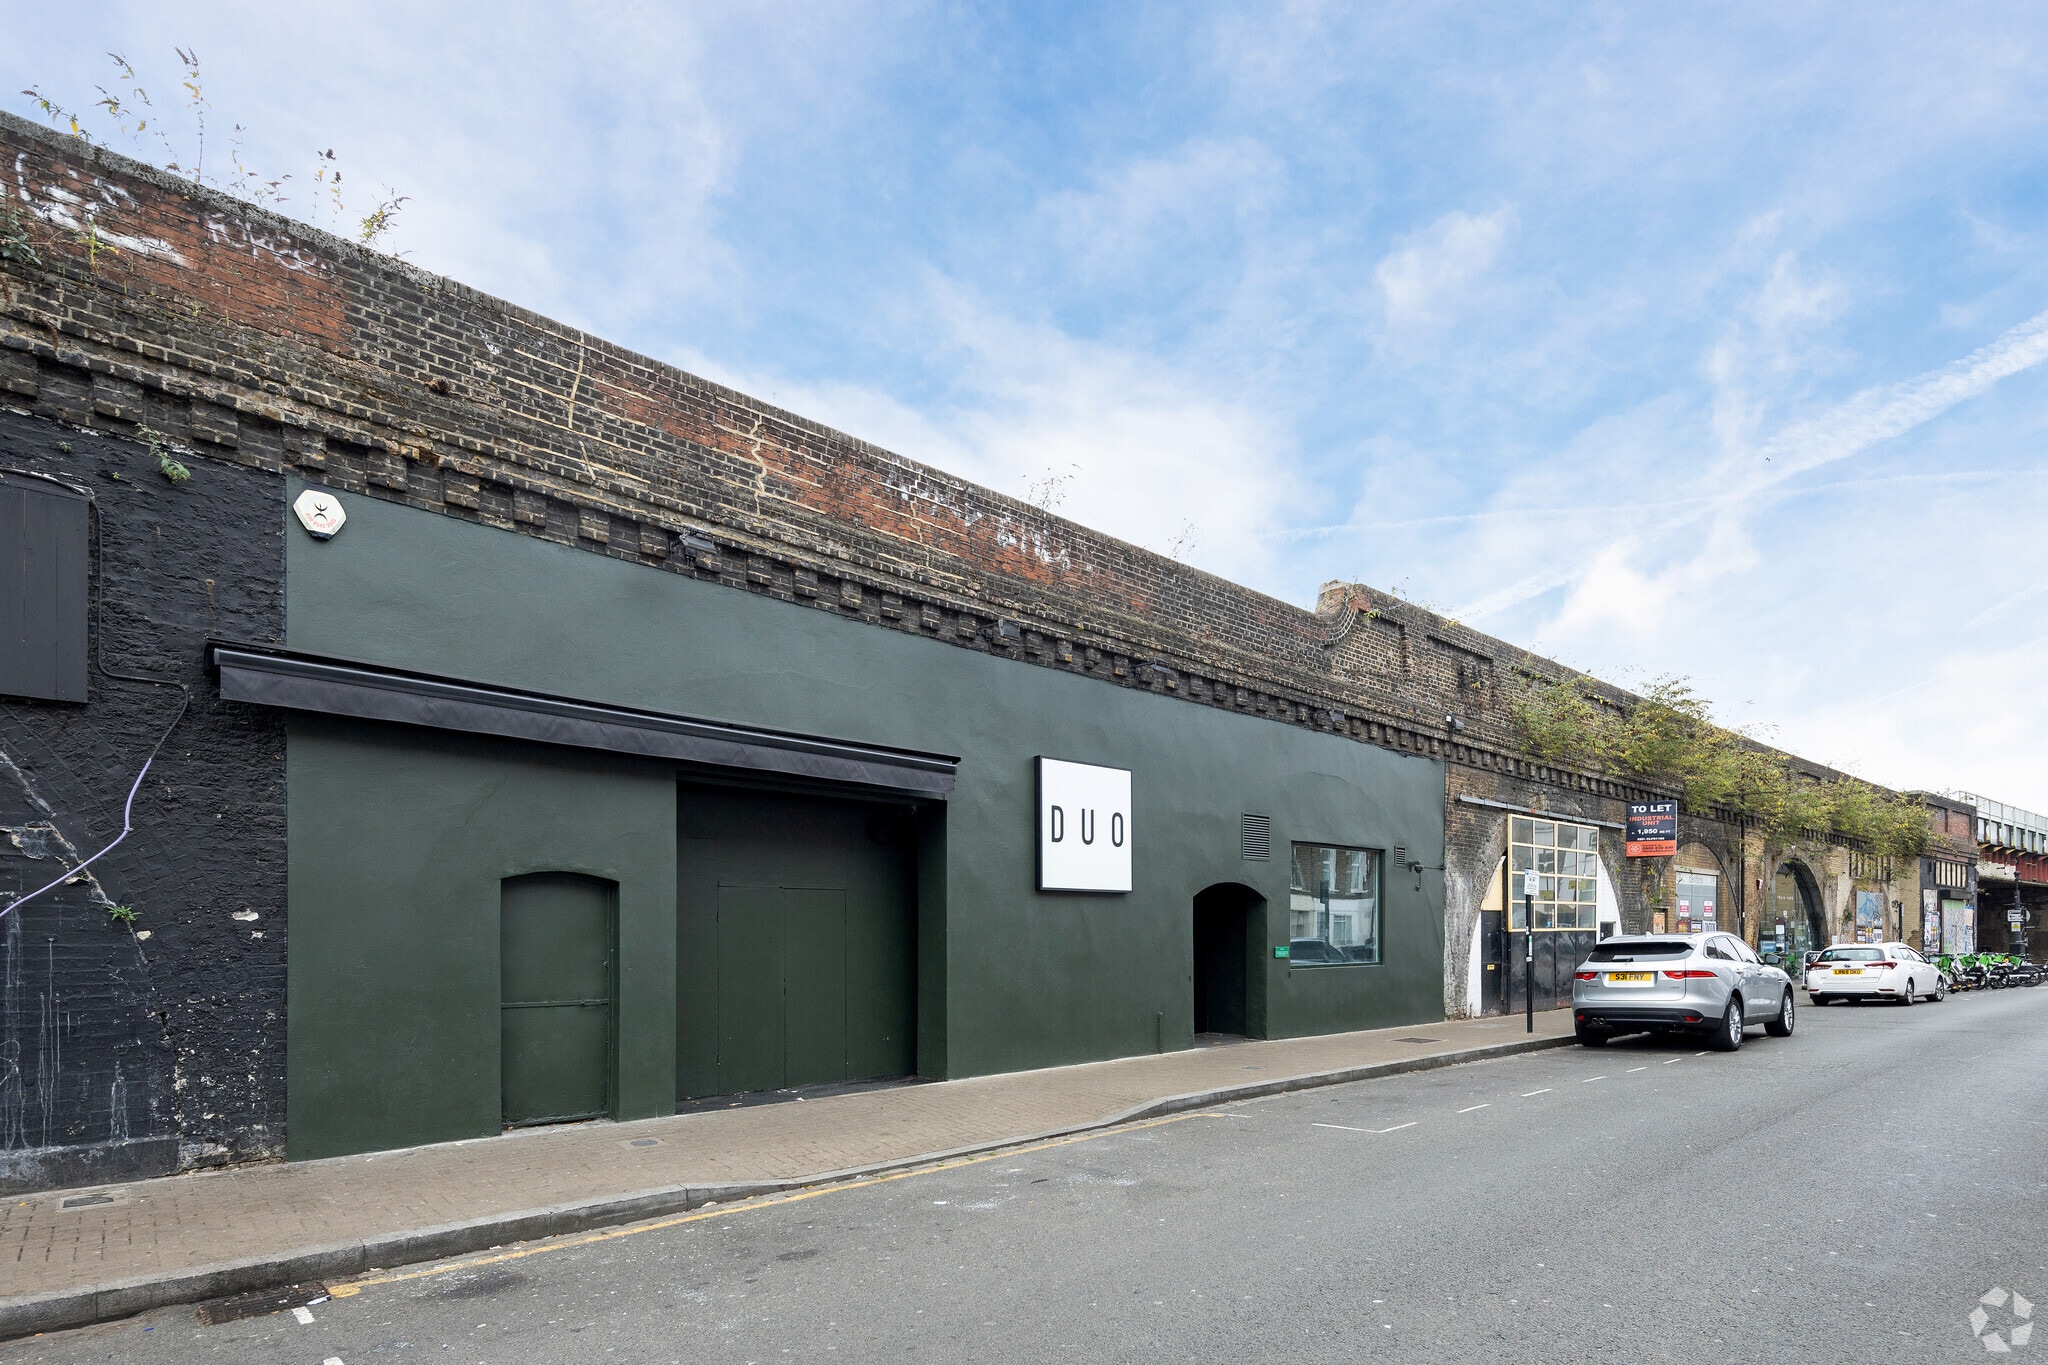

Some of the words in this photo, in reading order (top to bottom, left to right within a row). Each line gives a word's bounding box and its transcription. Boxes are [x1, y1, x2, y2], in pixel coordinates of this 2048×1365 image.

[1631, 805, 1647, 813] TO
[1650, 804, 1672, 812] LET
[1051, 804, 1124, 848] DUO
